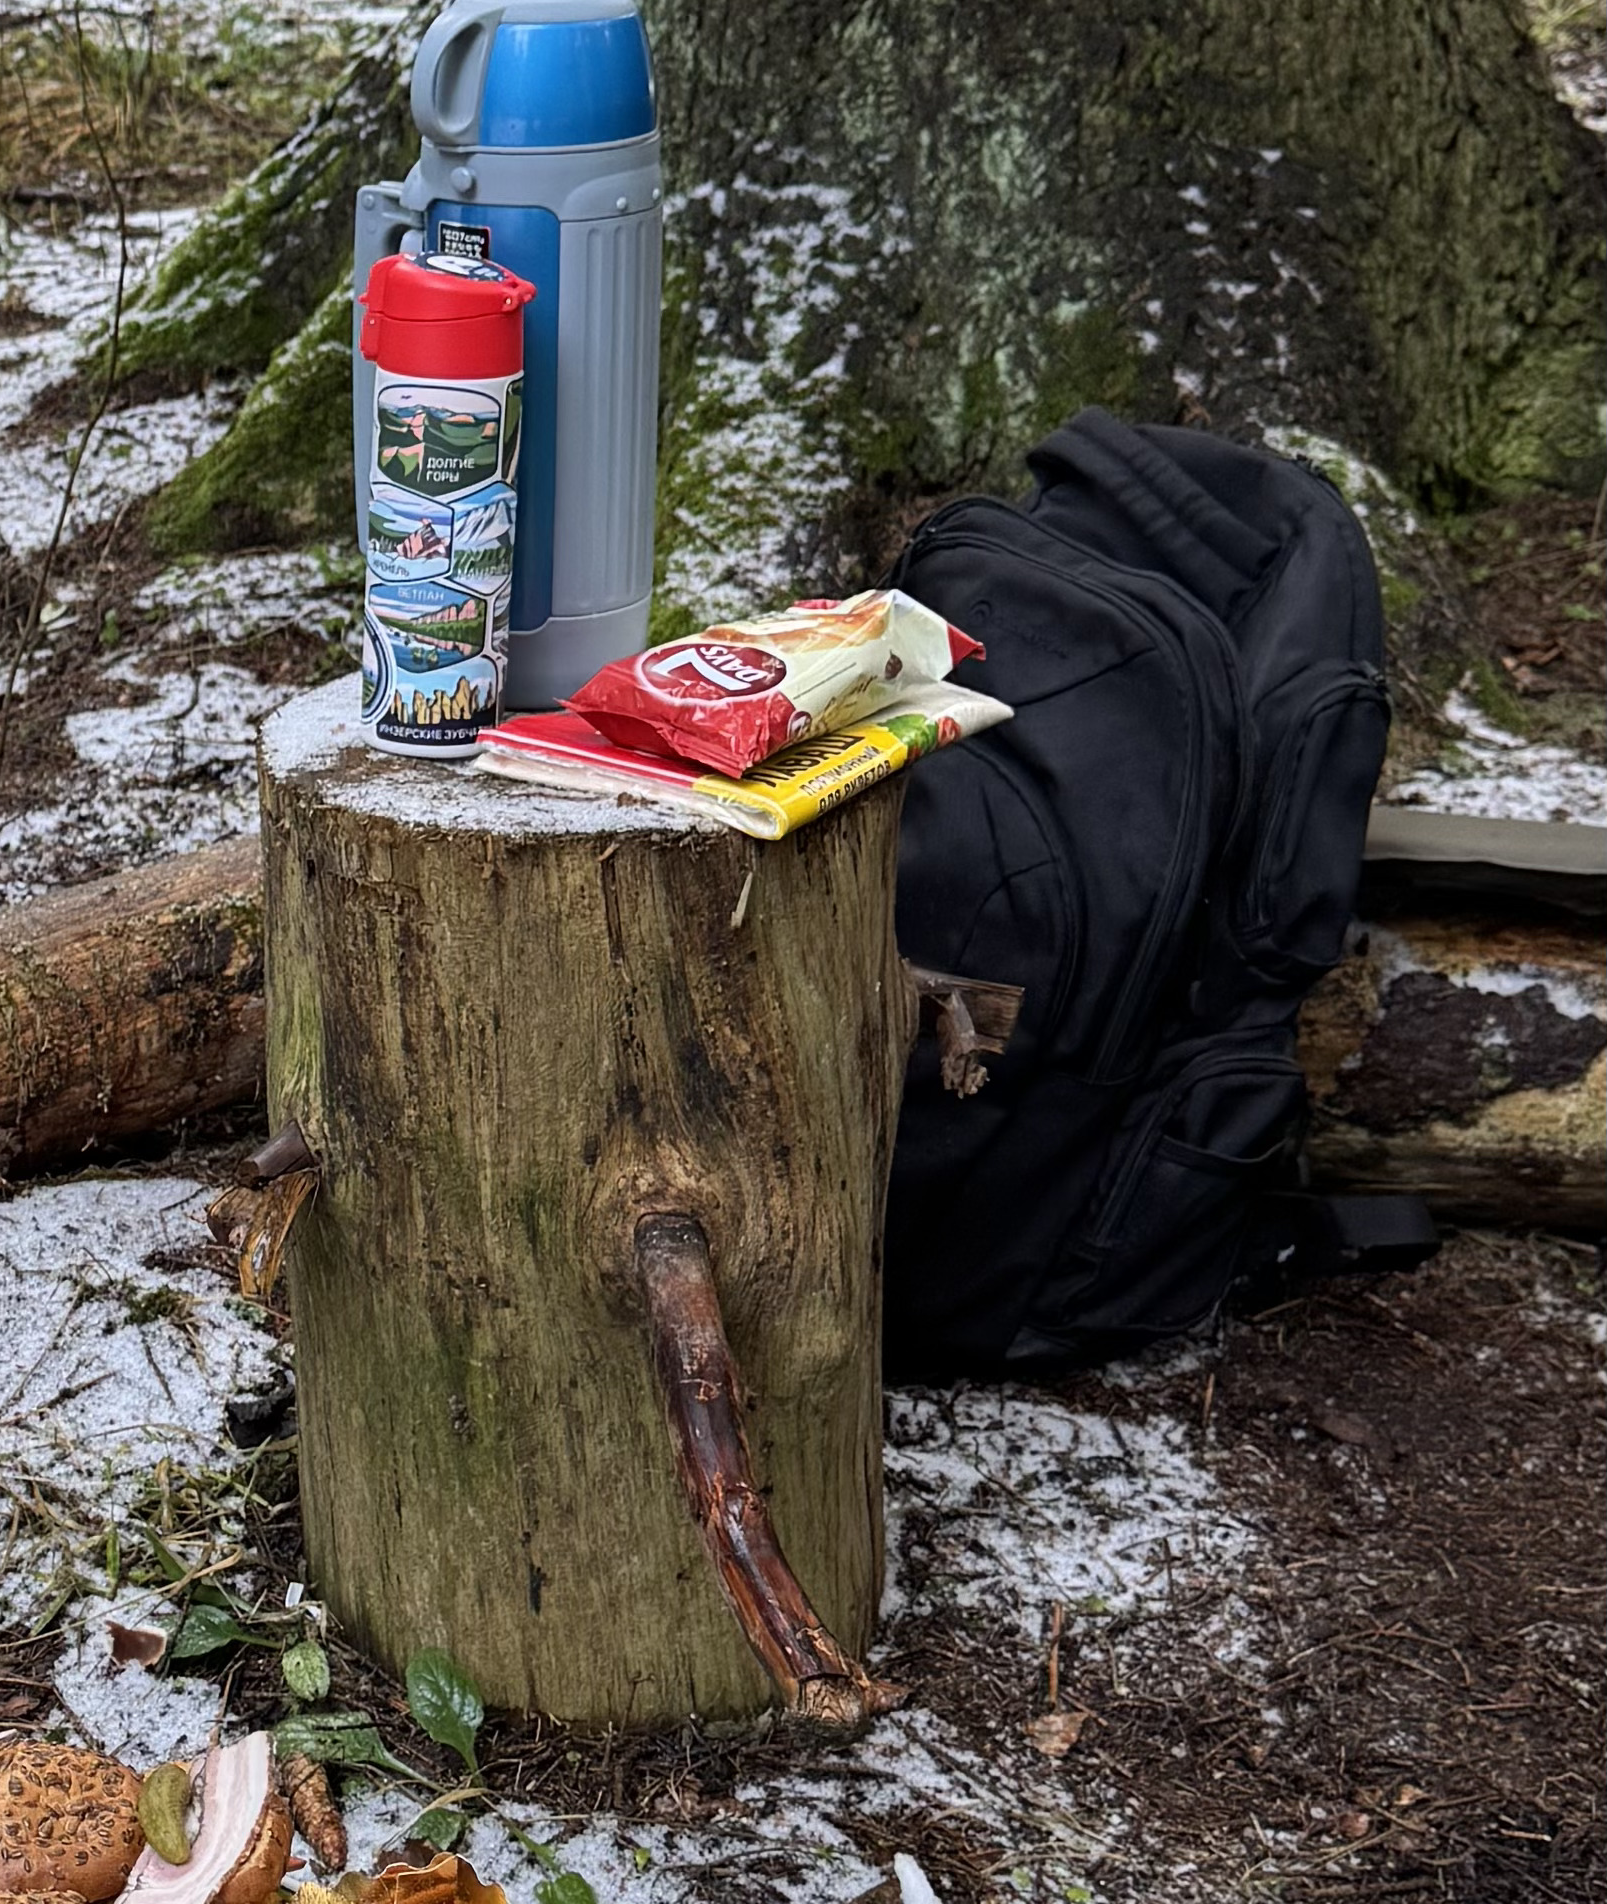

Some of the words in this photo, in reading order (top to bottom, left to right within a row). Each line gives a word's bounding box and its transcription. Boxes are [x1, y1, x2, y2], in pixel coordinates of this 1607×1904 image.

[426, 457, 475, 469] ДОЛГИЕ
[426, 471, 460, 482] ГОРЫ
[700, 645, 762, 682] DAYS
[817, 795, 842, 816] ДЛЯ
[843, 760, 892, 796] РУЛЕТОВ
